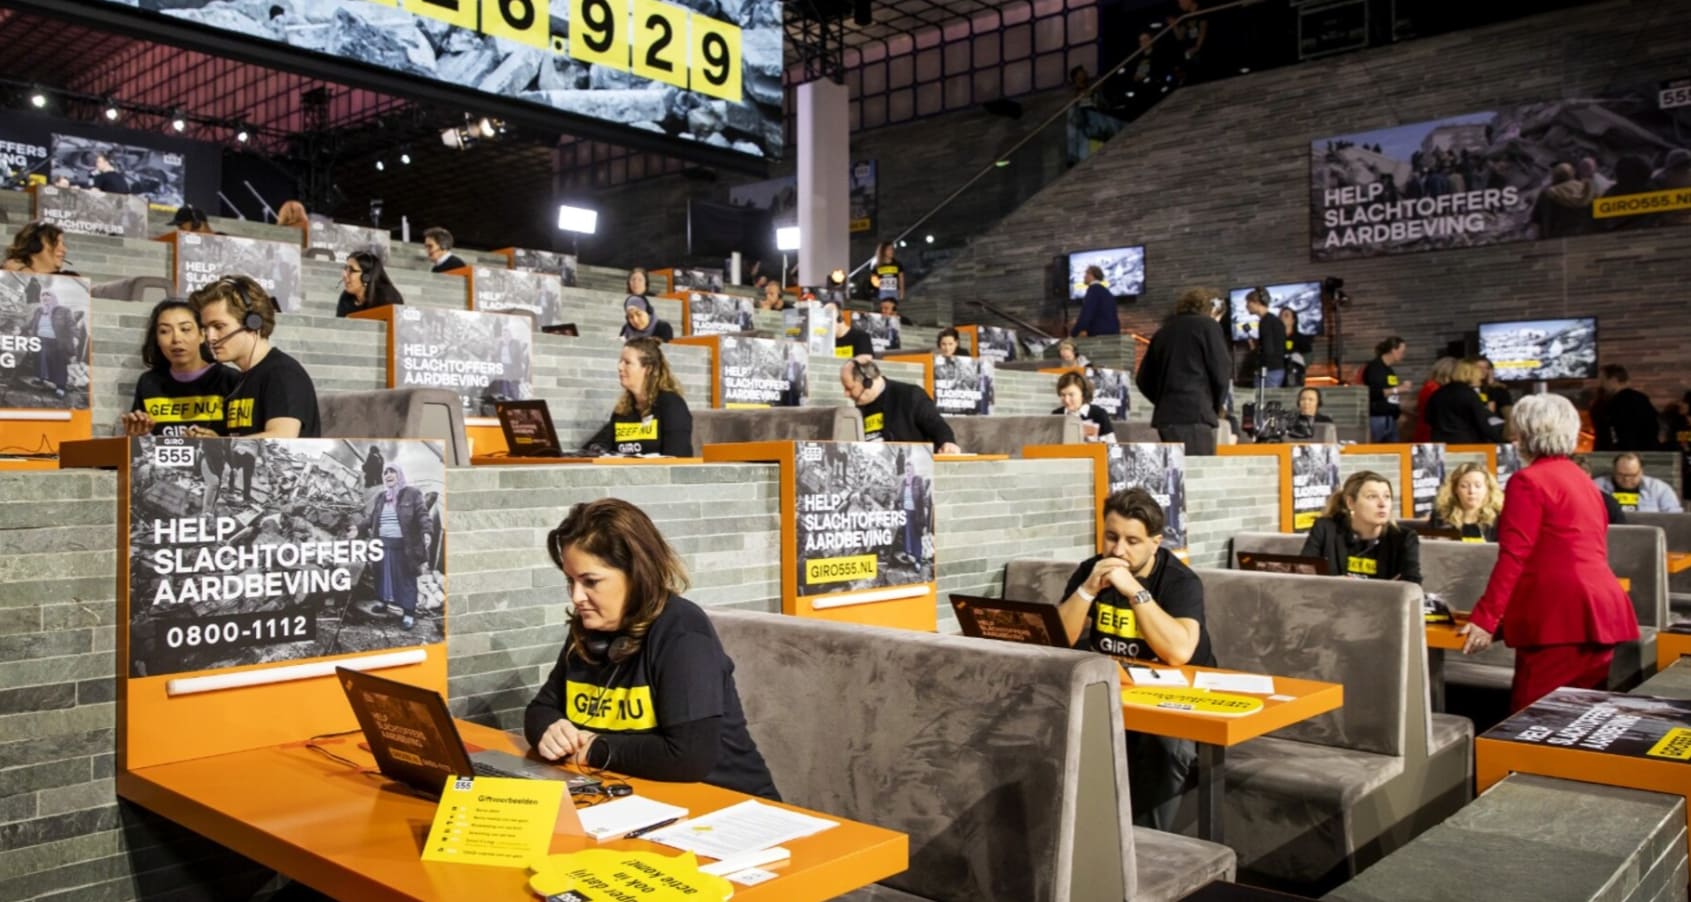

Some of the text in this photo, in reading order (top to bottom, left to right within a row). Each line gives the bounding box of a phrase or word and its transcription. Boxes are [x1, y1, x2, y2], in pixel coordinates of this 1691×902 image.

[1324, 182, 1384, 208] HELP
[1324, 186, 1520, 228] SLACHTOFFERS
[1324, 212, 1486, 249] AARDBEVING
[185, 260, 217, 273] HELP
[403, 343, 440, 357] HELP
[403, 357, 505, 375] SLACHTOFFERS
[403, 372, 490, 388] AARDBEVING
[151, 401, 217, 416] GEEF NU
[158, 448, 192, 463] 555
[804, 494, 841, 512] HELP
[153, 516, 237, 544] HELP
[804, 510, 908, 531] SLACHTOFFERS
[804, 529, 893, 551] AARDBEVING
[153, 538, 385, 574] SLACHTOFFERS
[810, 560, 875, 579] GIRO555.NL
[151, 567, 352, 606] AARDBEVING
[165, 615, 308, 648] 0800-1112
[1100, 637, 1140, 657] GIRO
